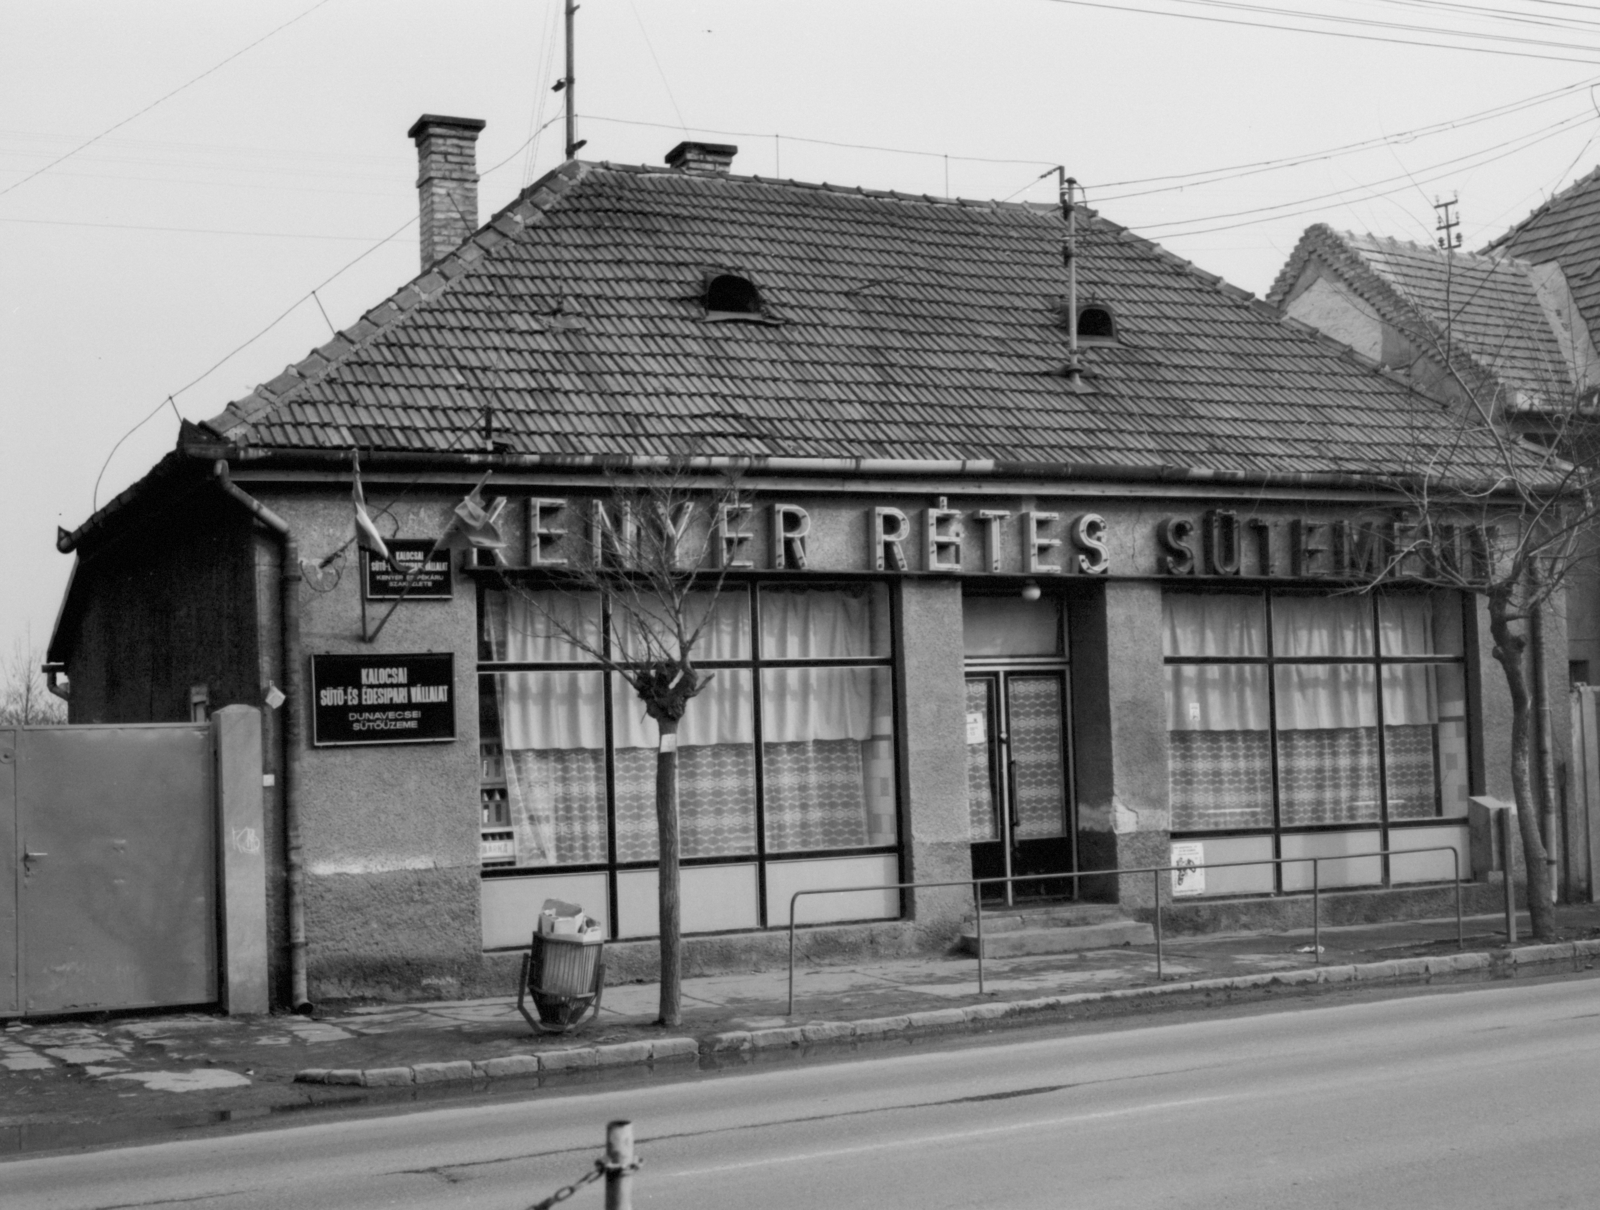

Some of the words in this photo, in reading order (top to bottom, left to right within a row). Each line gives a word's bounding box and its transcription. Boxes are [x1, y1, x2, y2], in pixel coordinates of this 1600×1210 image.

[870, 497, 1109, 573] RÉTES
[395, 551, 424, 560] KALOCSAI
[361, 667, 408, 685] KALOCSAI
[361, 686, 408, 705] ÉDESIPARI
[410, 684, 448, 703] VÁLLALAT
[348, 710, 421, 721] DUNAVECSEI
